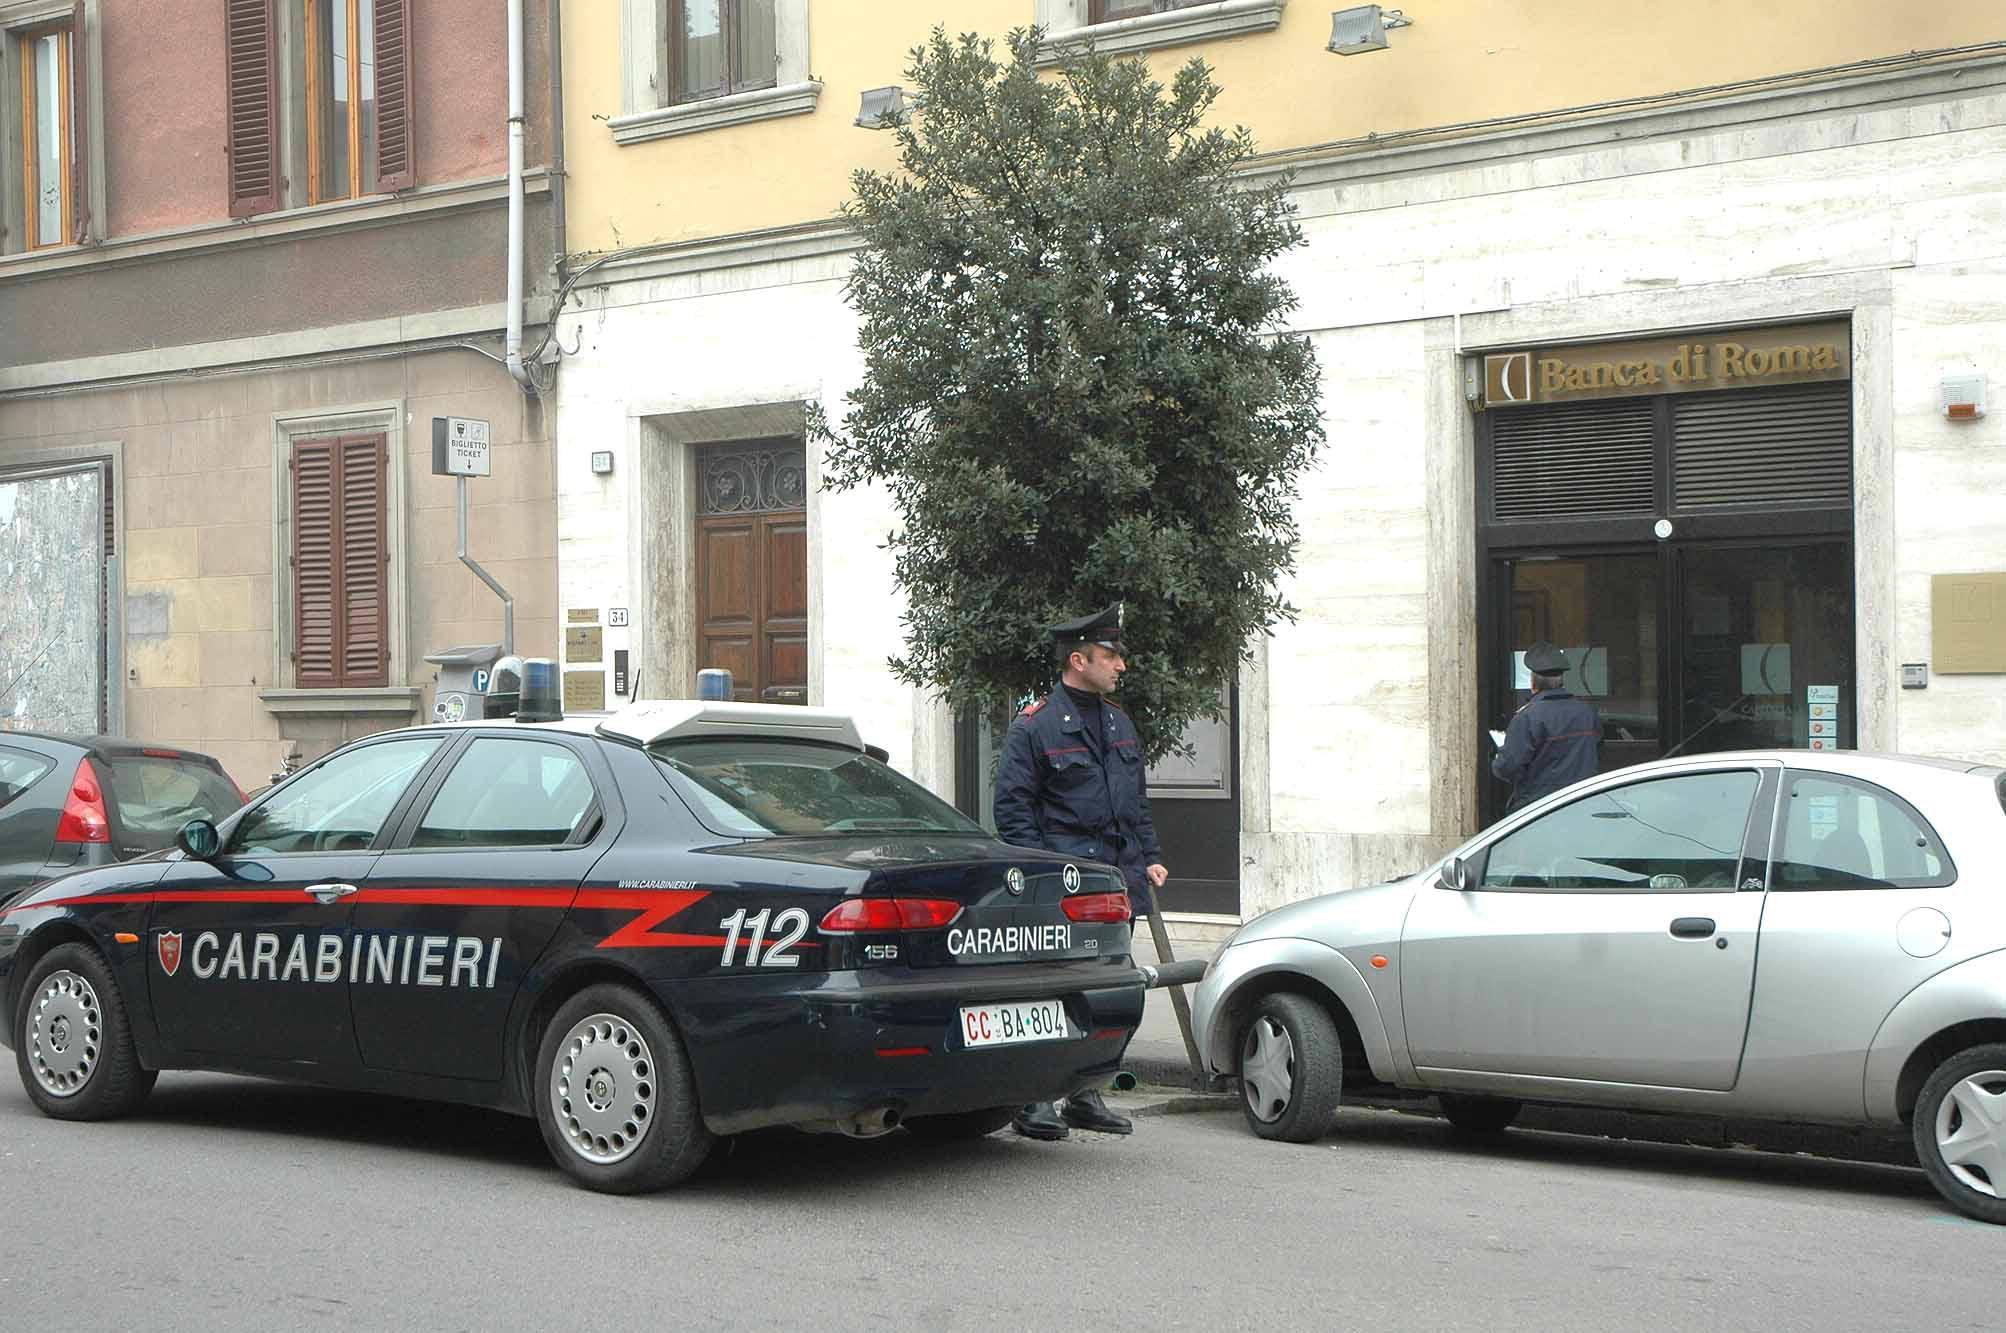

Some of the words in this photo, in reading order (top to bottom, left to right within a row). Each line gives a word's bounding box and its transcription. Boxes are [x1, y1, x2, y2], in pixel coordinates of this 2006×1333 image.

[1538, 357, 1658, 393] Banca
[1667, 344, 1706, 384] di
[1716, 342, 1837, 378] Roma
[451, 439, 487, 450] BIGLIETTO
[456, 449, 481, 458] TICKET
[612, 611, 624, 623] 34
[617, 879, 698, 890] WWW.CARABINIERI.IT
[1065, 870, 1077, 887] 41
[719, 907, 810, 967] 112
[947, 924, 1071, 955] CARABINIERI
[191, 930, 503, 988] CARABINIERI
[864, 944, 898, 960] 156
